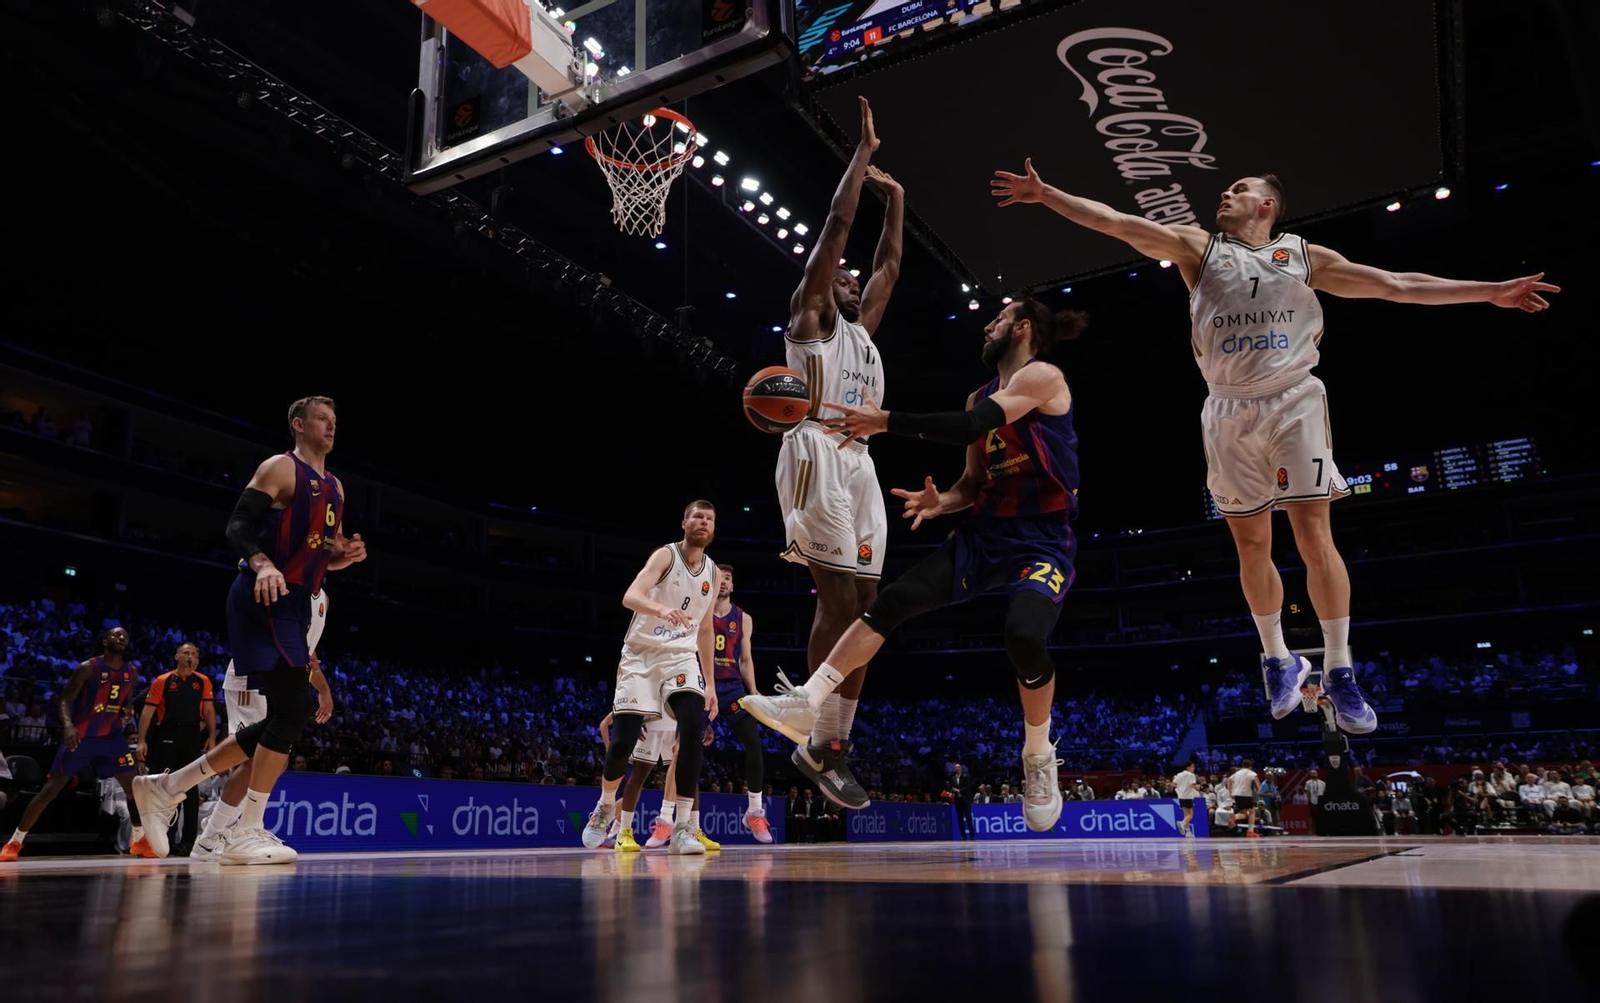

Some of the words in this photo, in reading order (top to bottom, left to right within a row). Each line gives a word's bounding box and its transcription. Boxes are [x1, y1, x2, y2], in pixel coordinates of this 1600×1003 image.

[897, 10, 939, 30] BARCELONA
[843, 38, 860, 50] 9:04
[868, 31, 877, 41] 11
[1057, 27, 1220, 180] Coca-Cola
[1134, 182, 1201, 226] aren
[1249, 277, 1260, 299] 7
[1213, 310, 1295, 328] OMNIYAT
[1222, 330, 1289, 353] dnata
[1312, 458, 1323, 487] 7
[1346, 474, 1373, 485] 9:03
[325, 502, 336, 527] 6
[1029, 562, 1065, 593] 23
[681, 596, 691, 611] 8
[715, 634, 726, 651] 8
[109, 684, 120, 699] 3
[125, 752, 135, 767] 3
[264, 790, 378, 836] dnata
[452, 796, 539, 836] dnata
[1324, 801, 1360, 811] dnata
[852, 810, 886, 834] dnata
[907, 811, 937, 834] dnata
[966, 811, 1028, 834] nata
[1080, 808, 1156, 833] dnata
